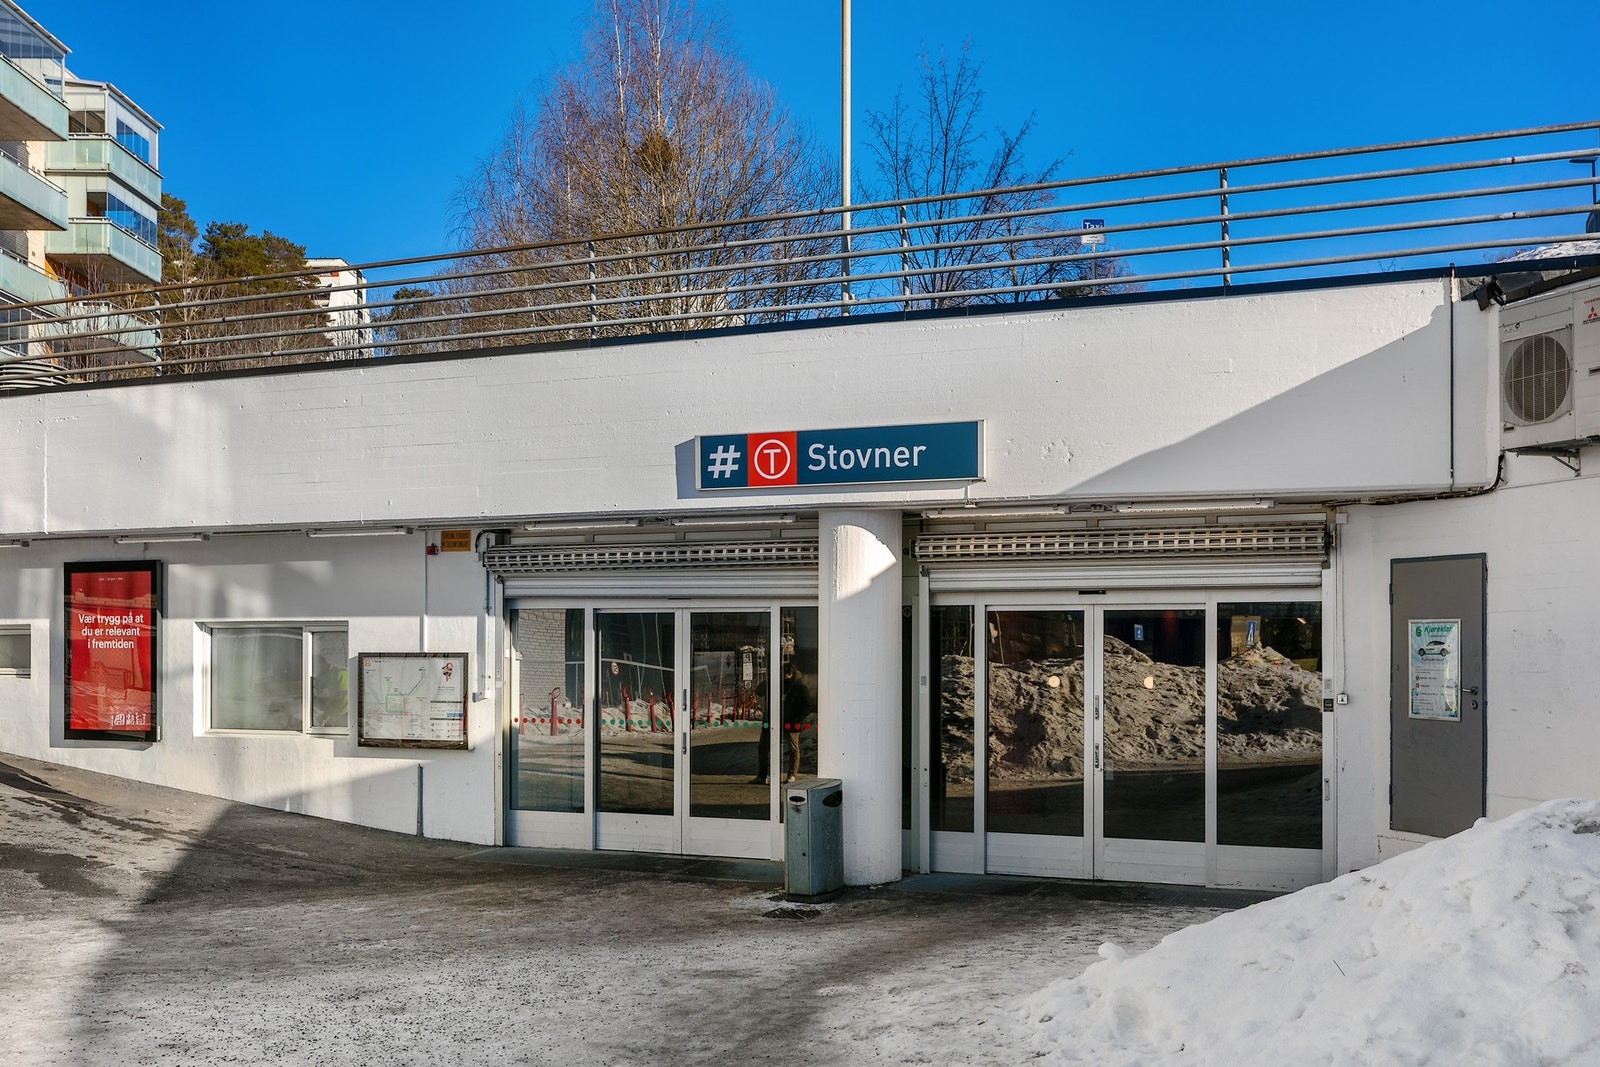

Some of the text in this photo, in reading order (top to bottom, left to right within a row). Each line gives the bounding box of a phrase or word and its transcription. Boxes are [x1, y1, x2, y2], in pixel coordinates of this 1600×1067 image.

[1084, 222, 1103, 230] Taxi
[808, 442, 927, 471] Stovner
[78, 611, 144, 625] Vær trygg på at
[81, 625, 140, 636] du er relevant
[87, 638, 134, 649] i fremtiden
